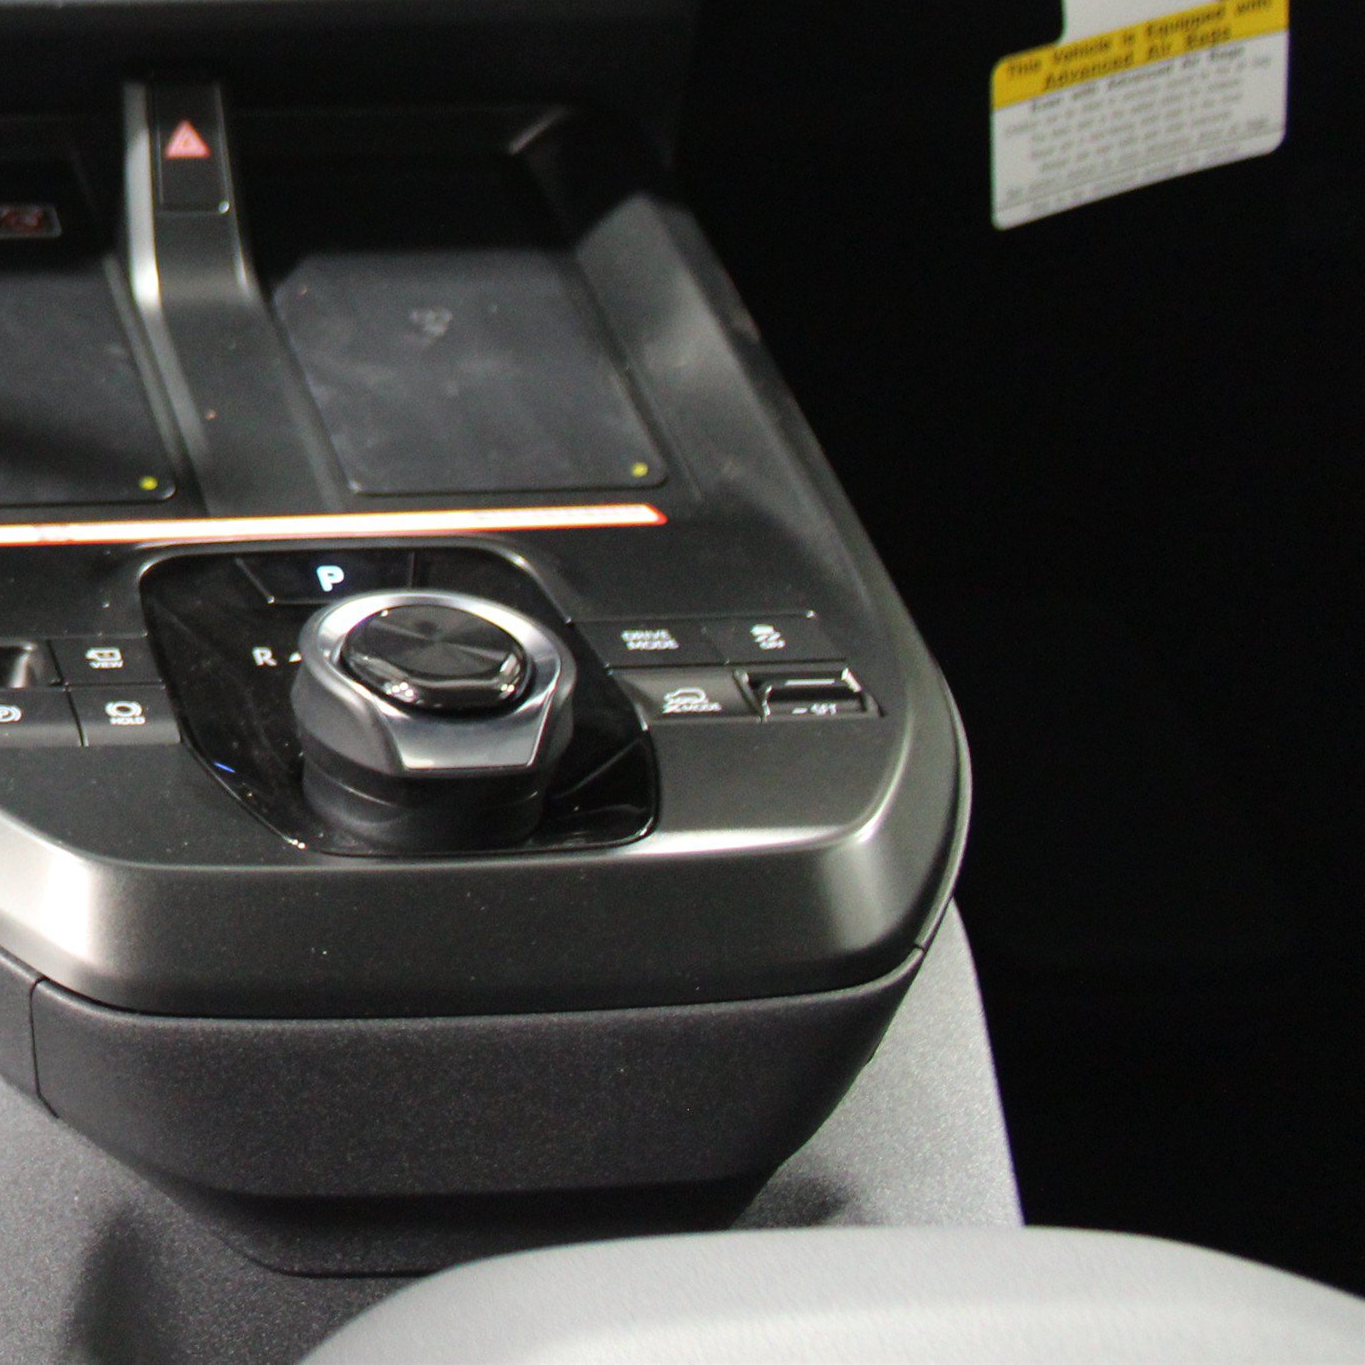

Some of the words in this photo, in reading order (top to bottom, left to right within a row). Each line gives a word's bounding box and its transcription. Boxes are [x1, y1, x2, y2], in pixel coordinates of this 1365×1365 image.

[315, 564, 346, 593] P
[625, 639, 679, 651] MODE
[251, 645, 278, 667] R
[89, 660, 124, 669] VIEW
[108, 715, 146, 726] HOLD
